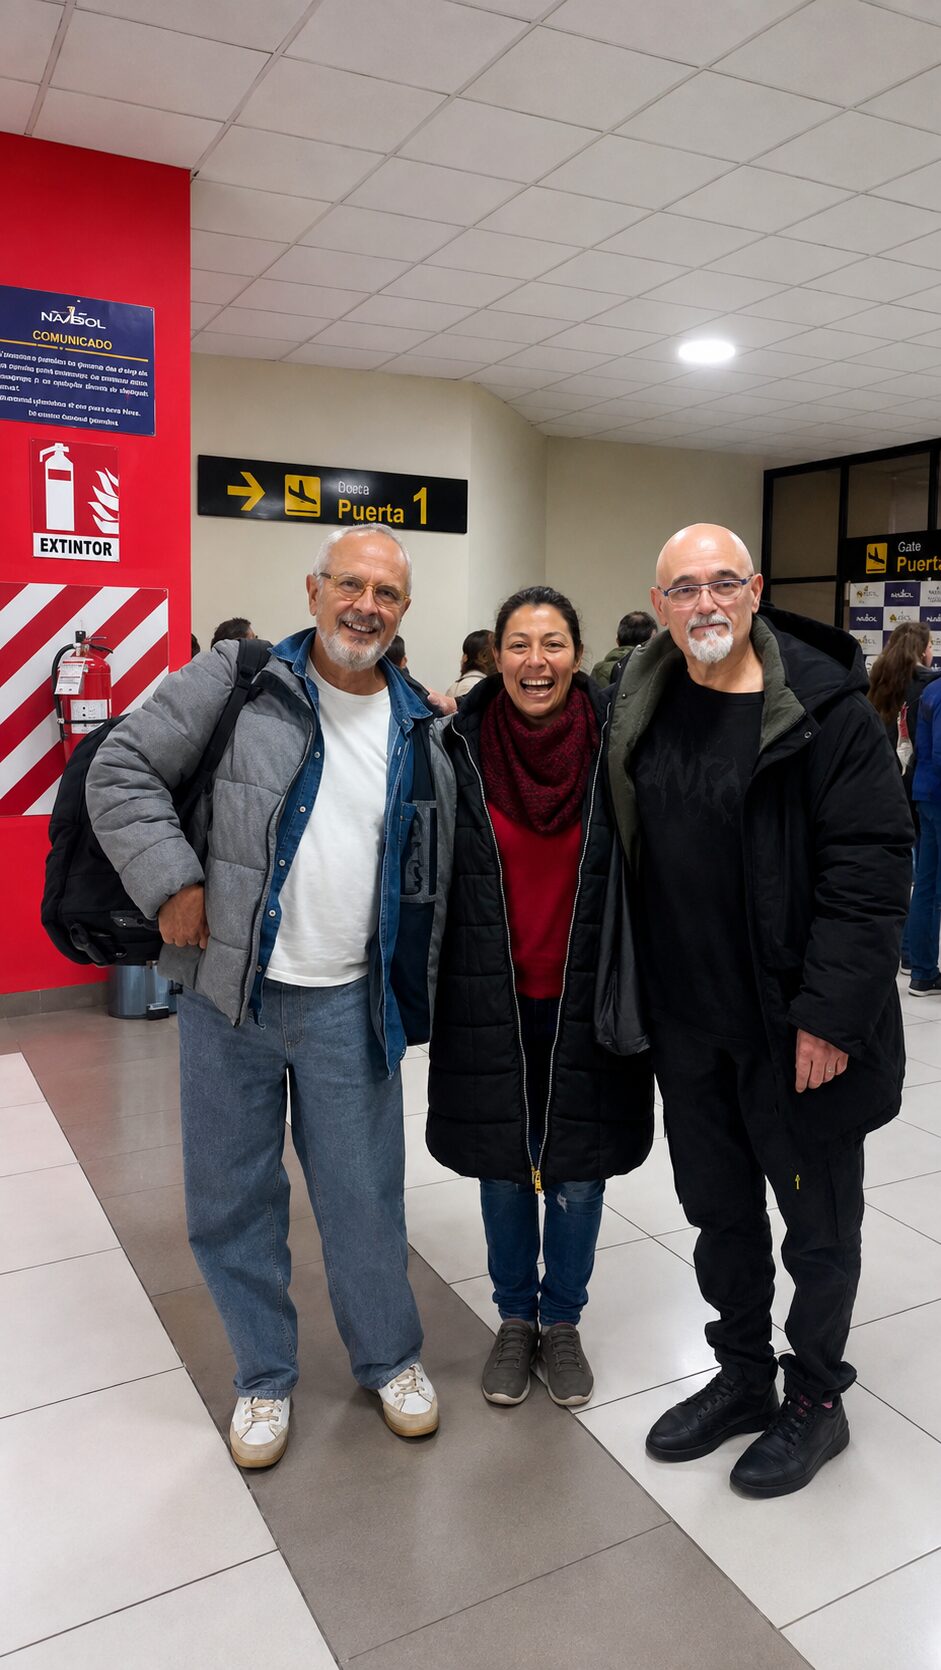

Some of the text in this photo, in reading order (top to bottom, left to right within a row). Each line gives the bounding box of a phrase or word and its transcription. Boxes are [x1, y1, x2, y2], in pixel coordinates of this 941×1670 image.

[32, 330, 113, 350] COMUNICADO
[338, 486, 427, 525] Puerta 1
[40, 537, 112, 556] EXTINTOR
[897, 541, 922, 552] Gate
